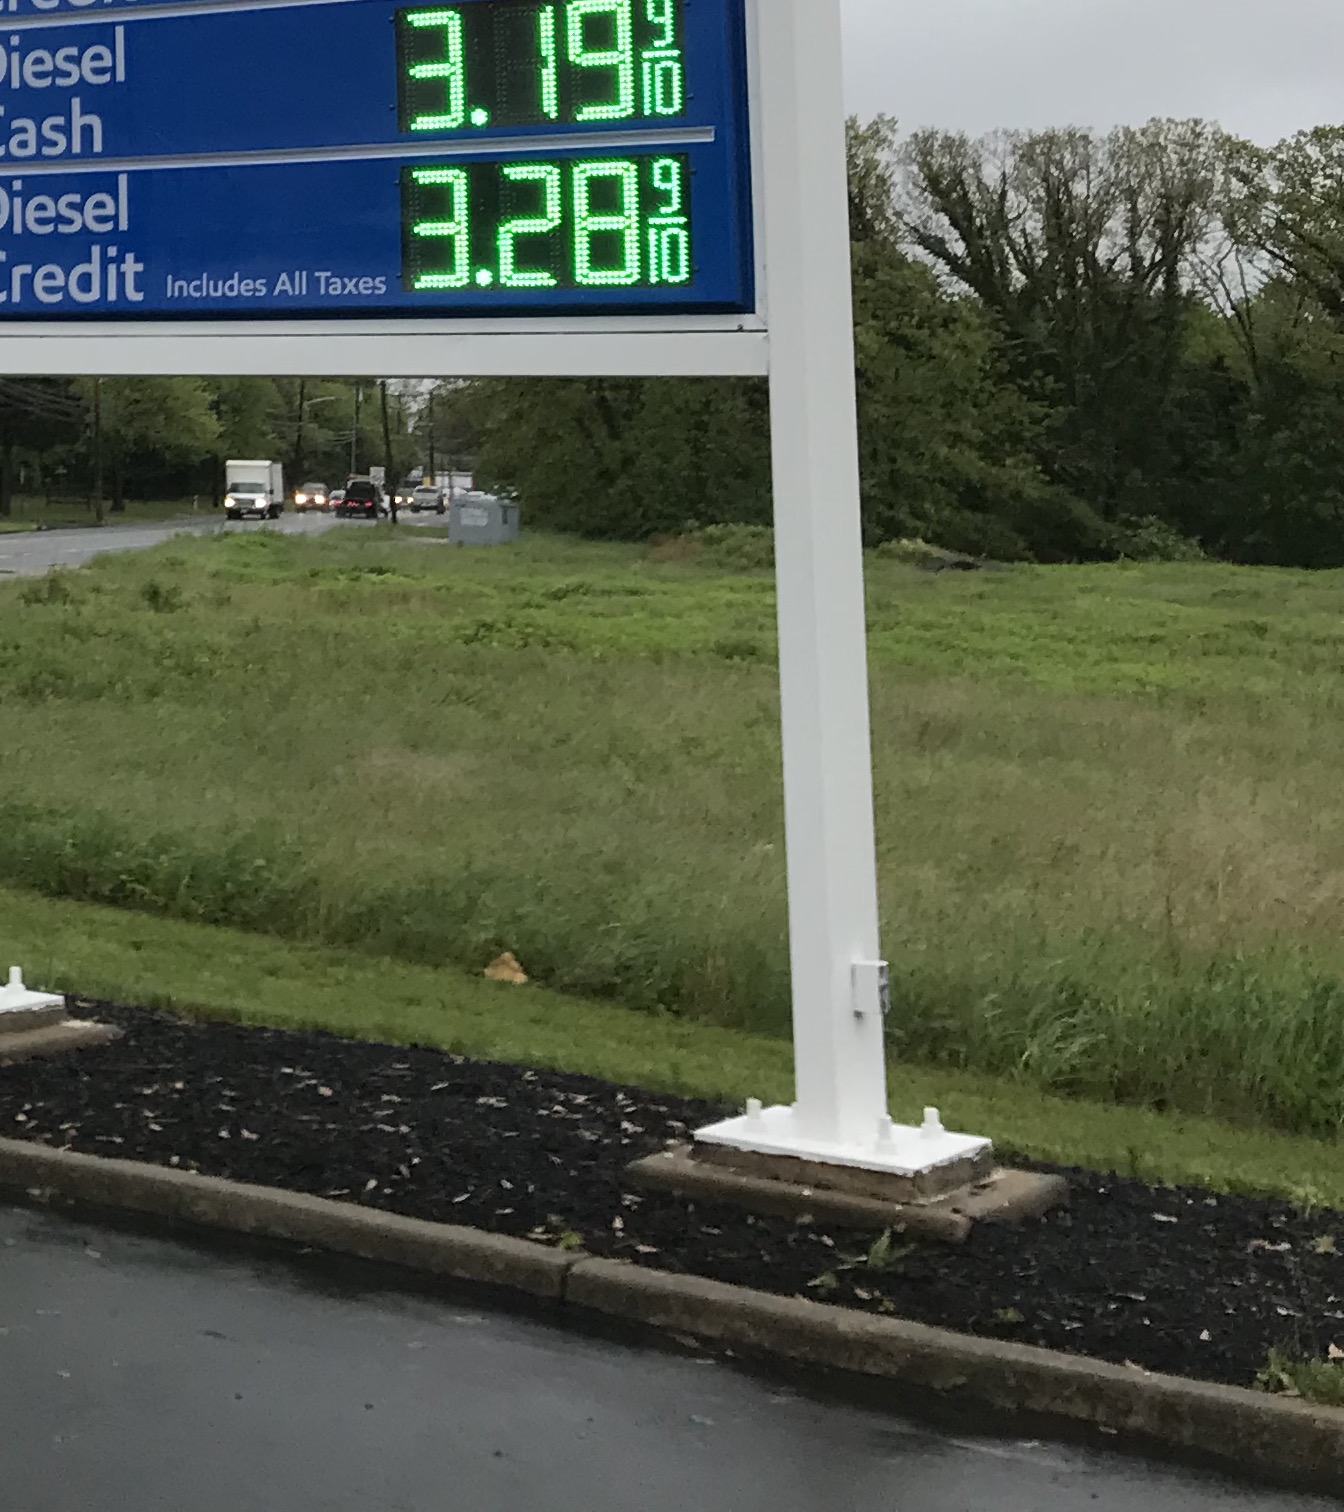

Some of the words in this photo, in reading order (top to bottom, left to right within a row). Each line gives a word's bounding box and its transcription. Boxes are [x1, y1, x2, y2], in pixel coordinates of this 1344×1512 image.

[166, 271, 267, 298] Includes
[273, 270, 307, 296] All
[315, 271, 387, 295] Taxes
